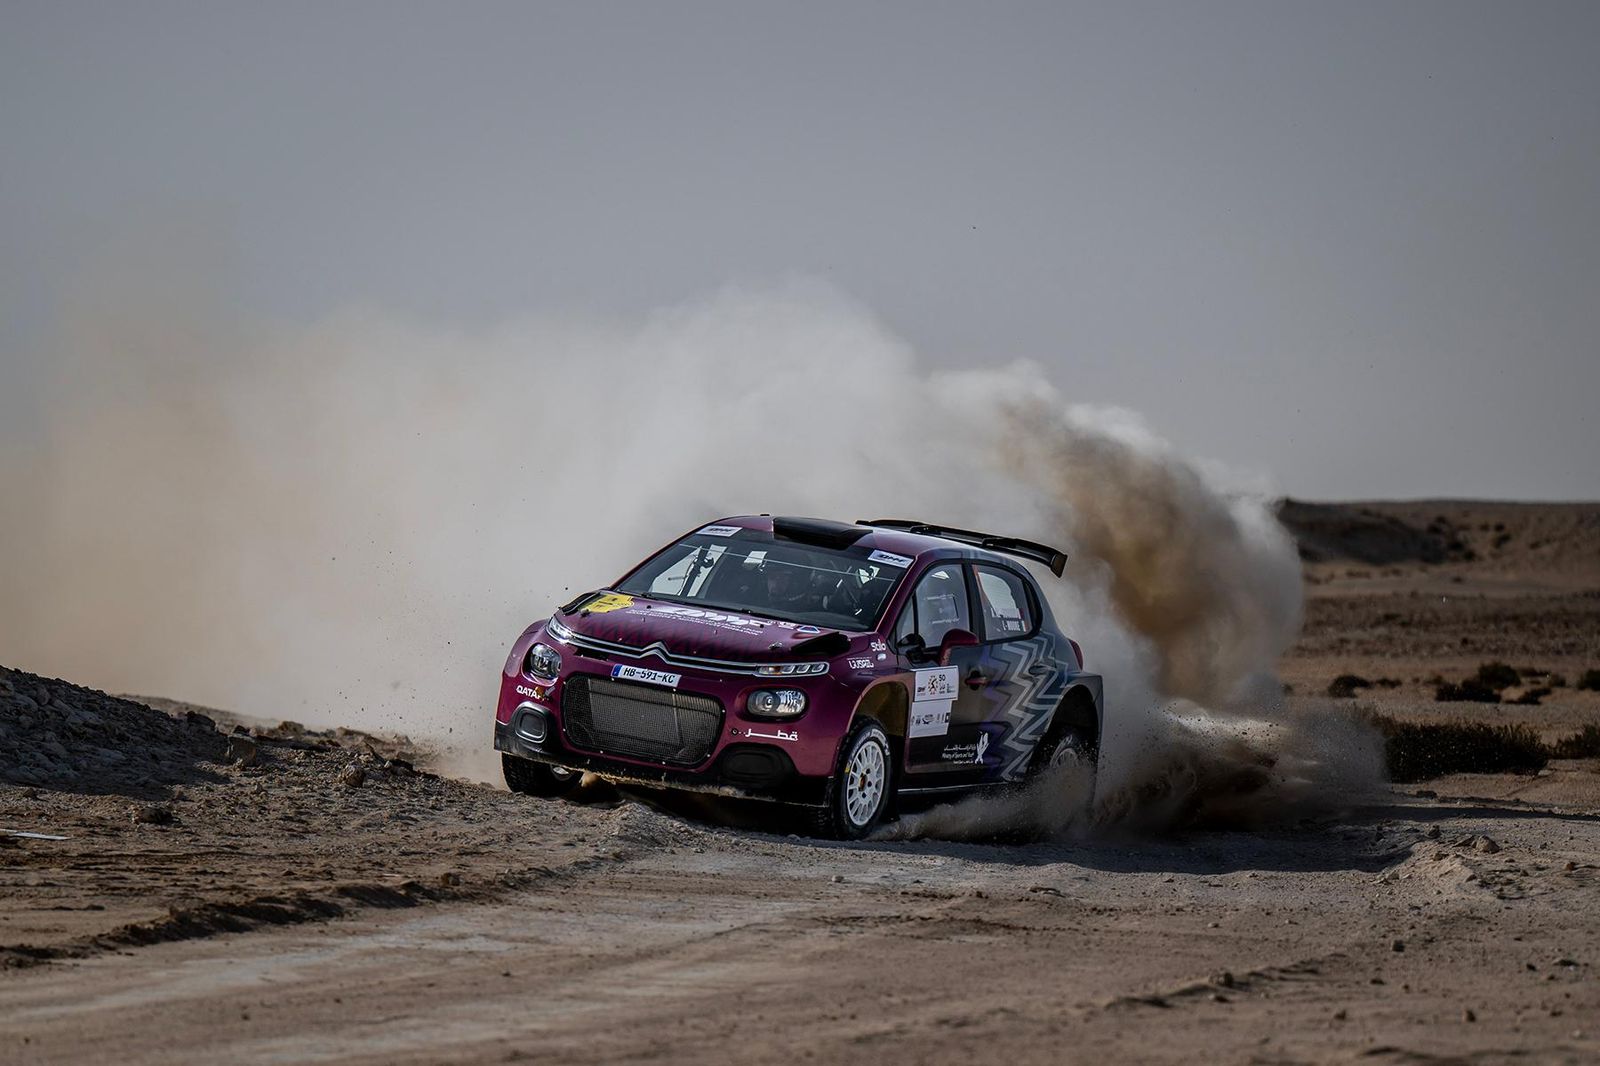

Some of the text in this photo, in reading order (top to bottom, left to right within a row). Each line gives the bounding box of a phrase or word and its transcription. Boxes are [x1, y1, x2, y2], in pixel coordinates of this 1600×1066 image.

[623, 667, 676, 684] HB-591-KC
[938, 674, 946, 682] 50
[516, 684, 545, 701] QATA
[744, 728, 799, 742] قطر
